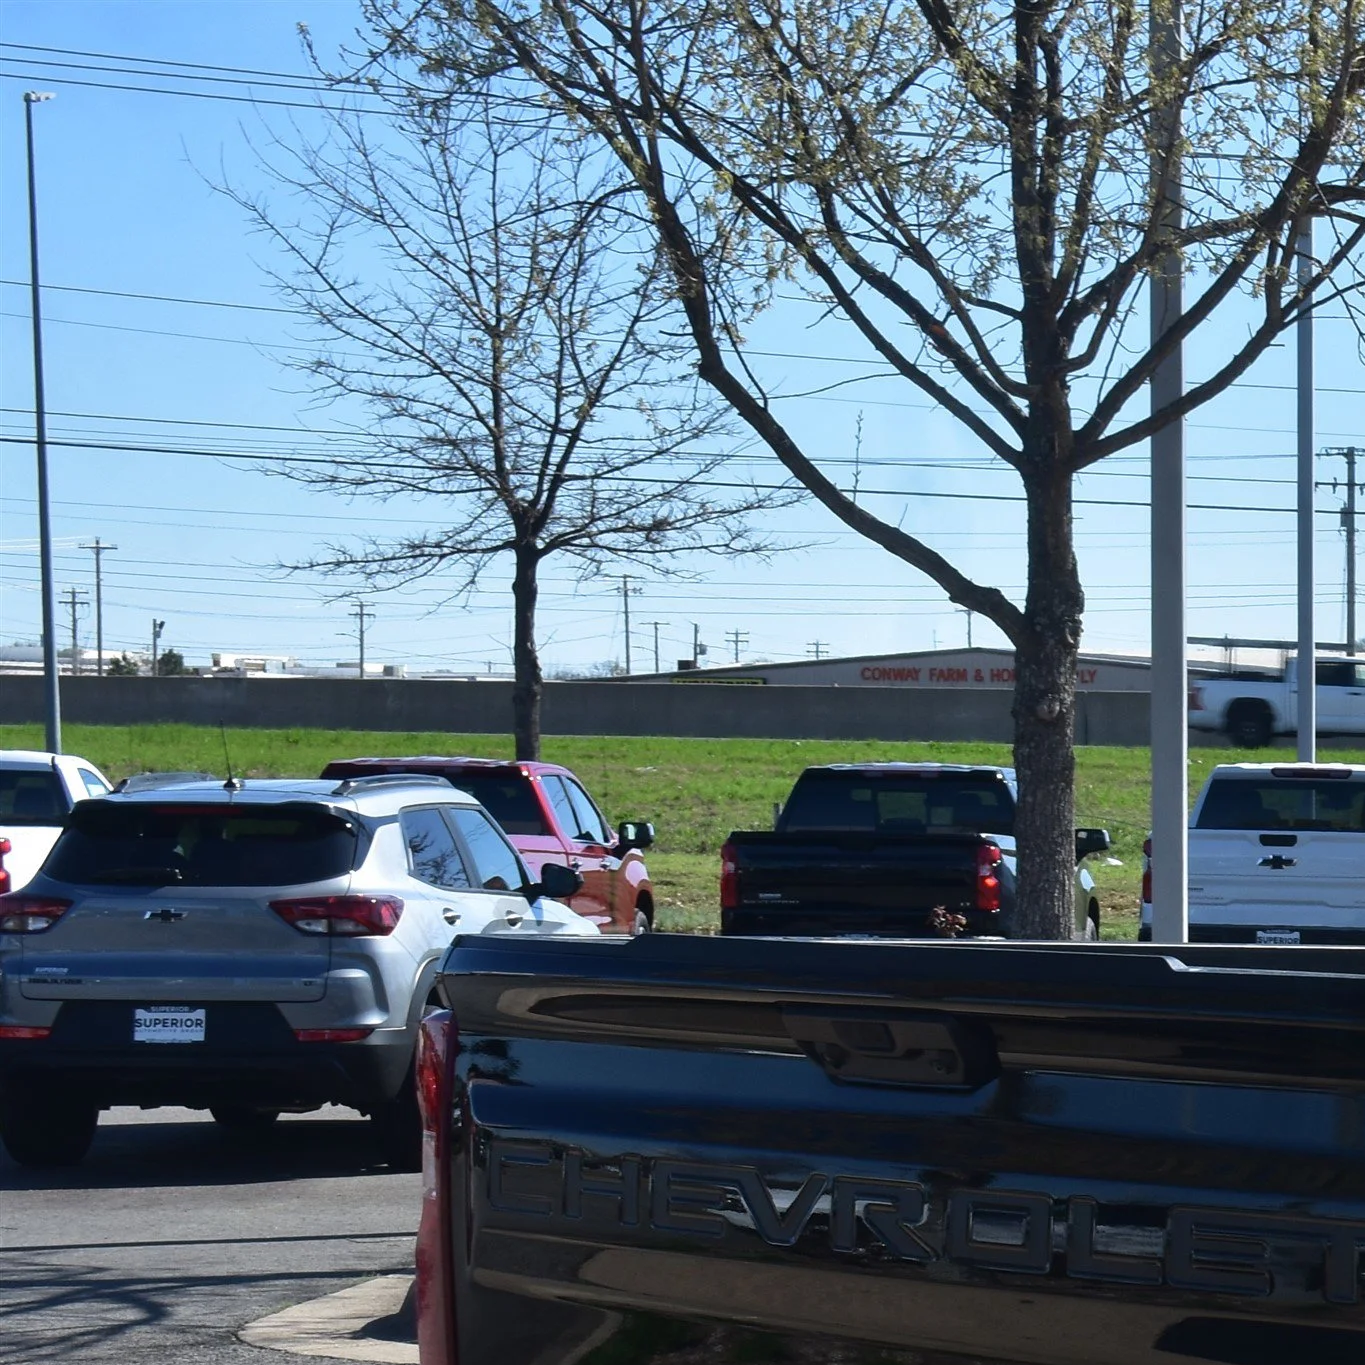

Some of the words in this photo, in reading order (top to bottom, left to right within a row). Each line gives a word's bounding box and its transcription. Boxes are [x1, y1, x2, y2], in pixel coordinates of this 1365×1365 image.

[861, 667, 921, 682] CONWAY
[929, 668, 968, 682] FARM
[974, 668, 984, 682] &
[134, 1018, 204, 1028] SUPERIOR
